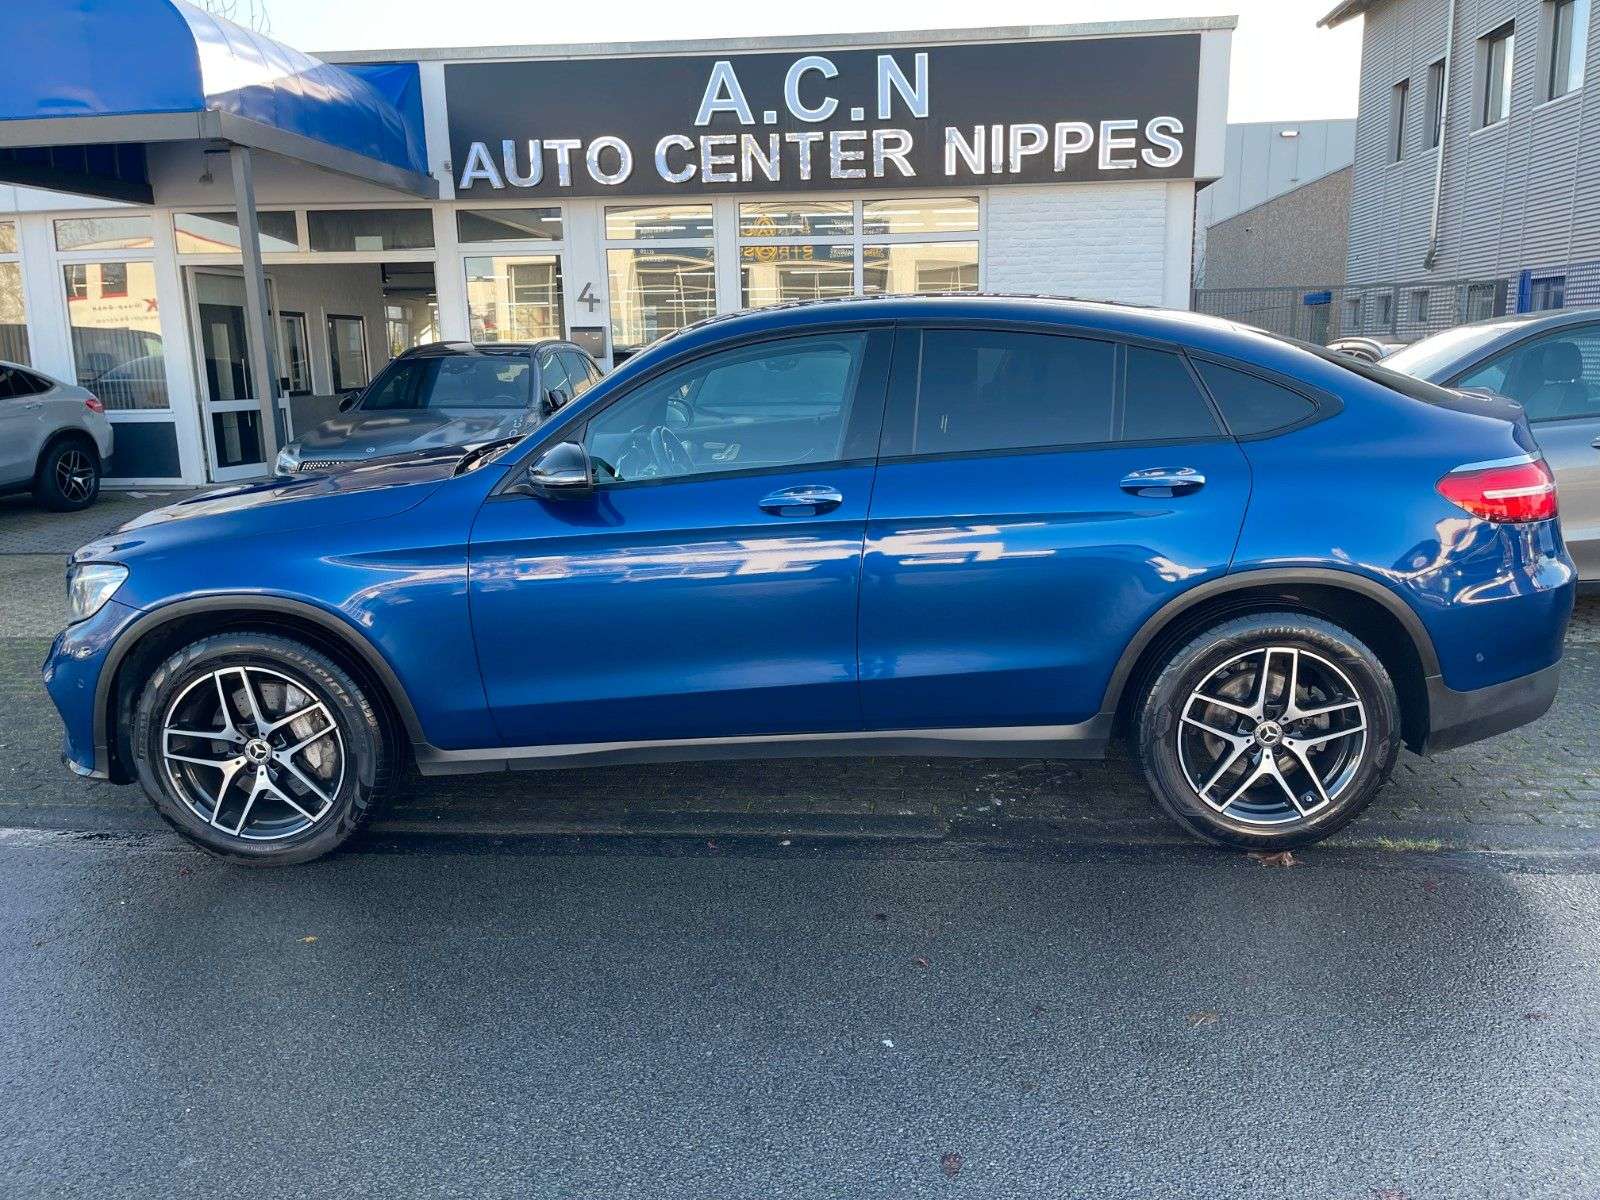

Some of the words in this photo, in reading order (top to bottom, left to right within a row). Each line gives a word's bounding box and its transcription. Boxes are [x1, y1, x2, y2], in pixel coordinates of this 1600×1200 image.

[694, 52, 929, 126] A.C.N
[459, 135, 634, 189] AUTO
[654, 128, 917, 184] CENTER
[945, 116, 1184, 176] NIPPES
[577, 281, 600, 312] 4
